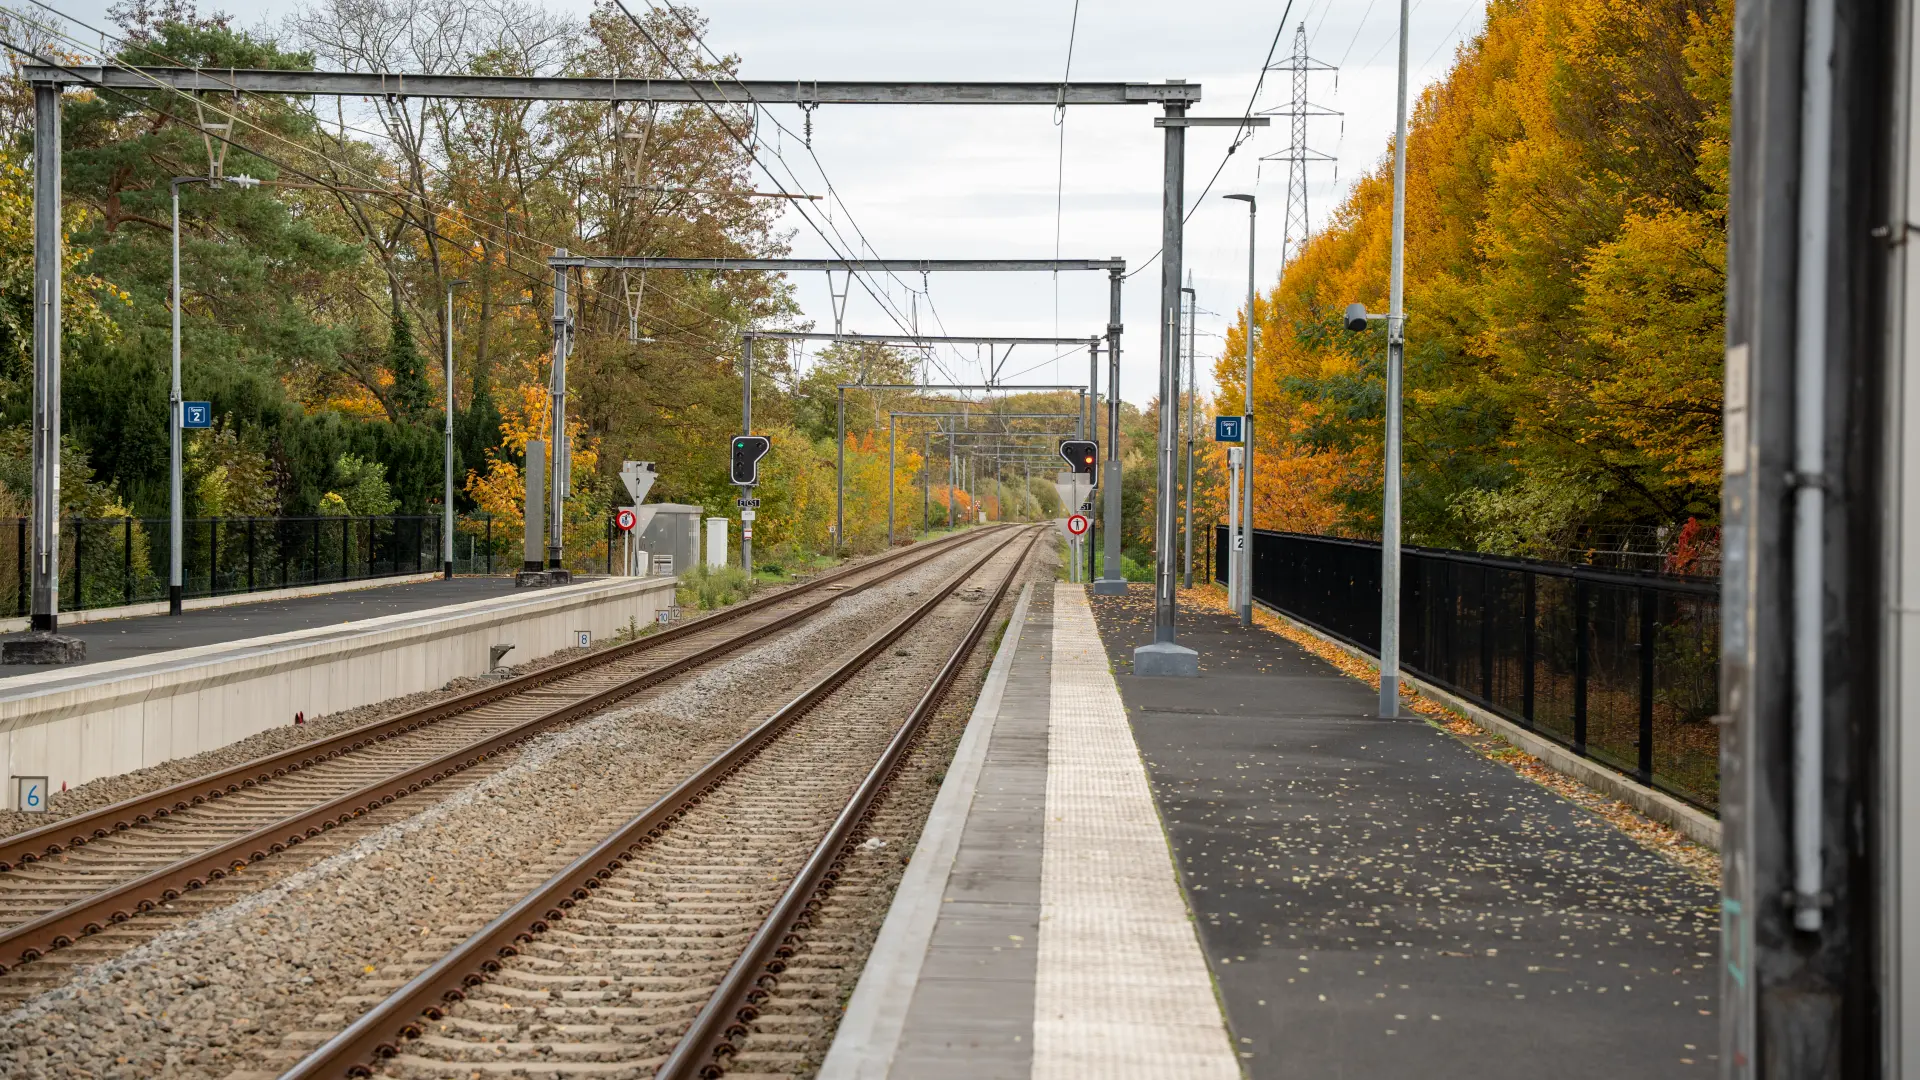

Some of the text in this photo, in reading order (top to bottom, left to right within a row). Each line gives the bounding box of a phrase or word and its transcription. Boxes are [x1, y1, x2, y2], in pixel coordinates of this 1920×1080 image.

[193, 412, 200, 421] 2
[1226, 426, 1231, 436] 1
[1237, 538, 1243, 548] 2
[660, 612, 668, 622] 10
[673, 609, 680, 618] 12
[581, 634, 588, 644] 8
[27, 785, 39, 806] 6
